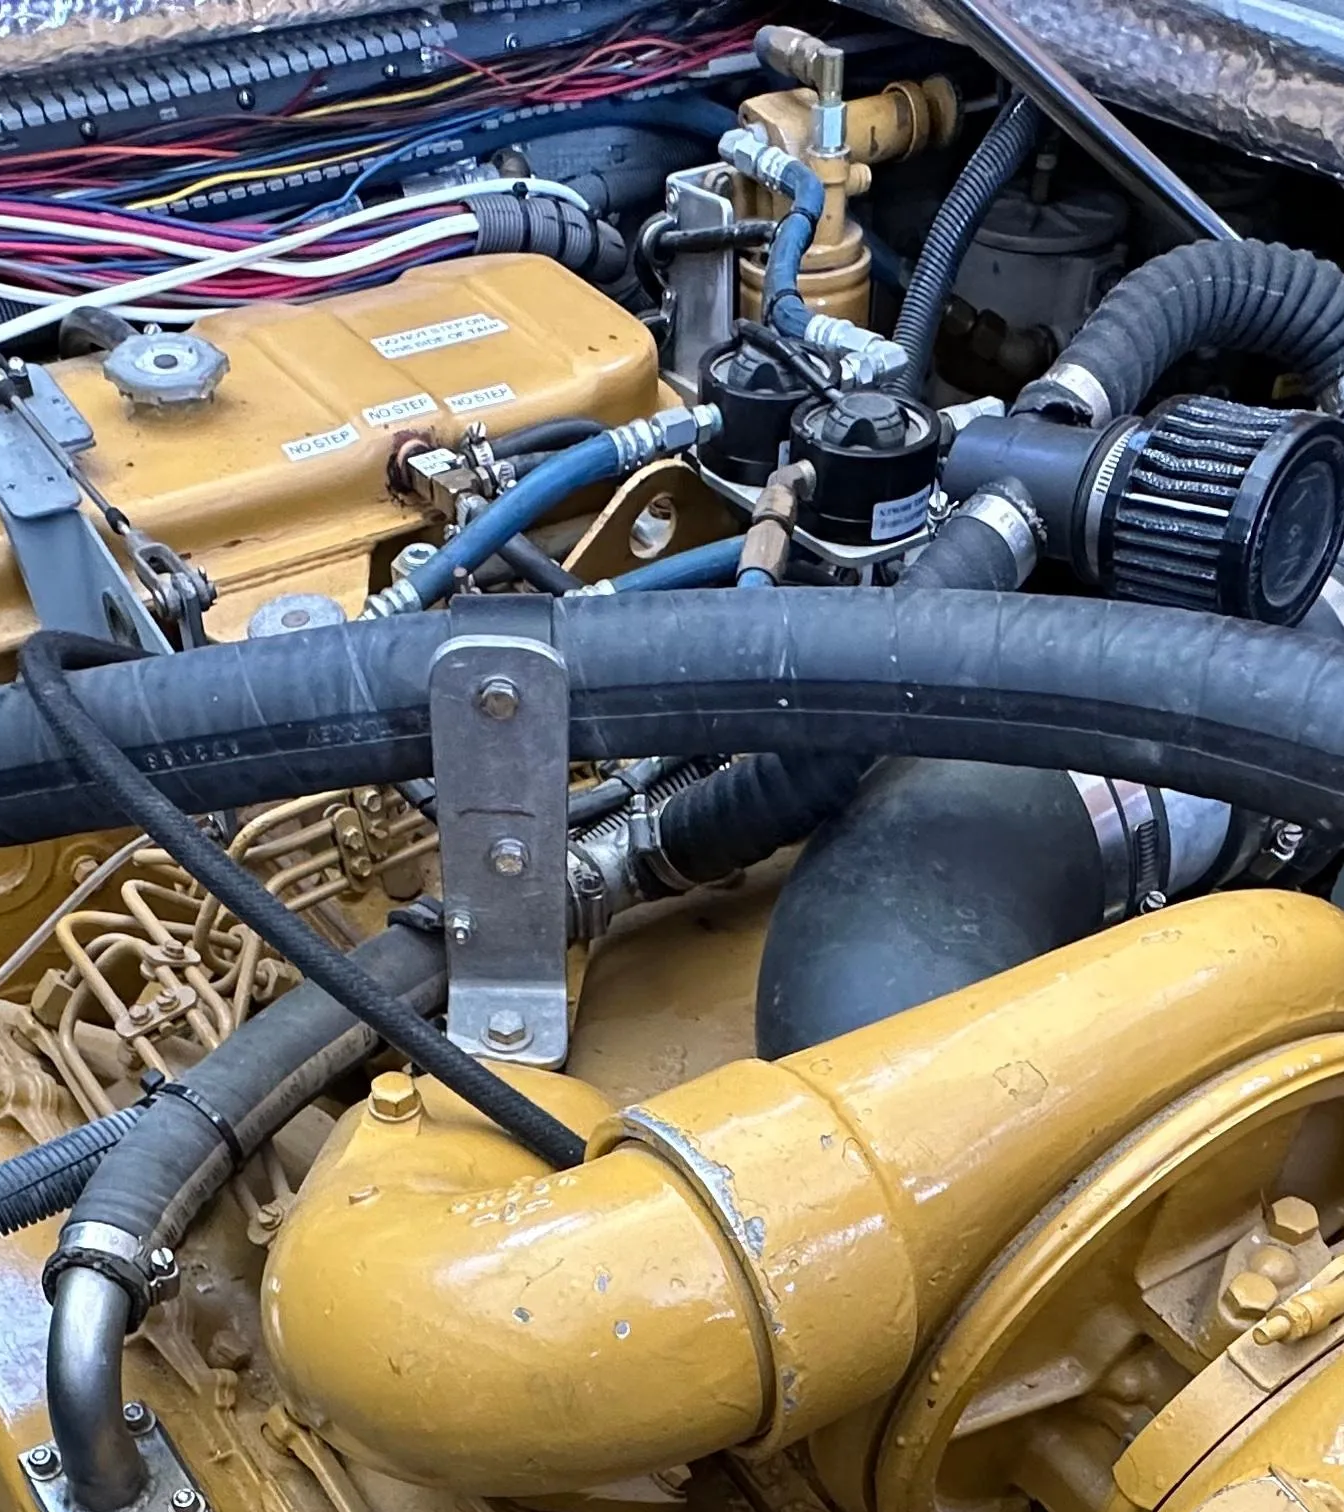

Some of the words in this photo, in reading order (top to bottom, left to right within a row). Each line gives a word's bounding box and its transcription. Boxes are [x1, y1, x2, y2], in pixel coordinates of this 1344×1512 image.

[399, 331, 427, 342] NOT
[430, 322, 463, 334] STEP
[447, 330, 465, 340] OF
[450, 395, 473, 408] NO
[473, 387, 509, 403] STEP
[368, 407, 391, 421] NO
[394, 397, 429, 415] STEP
[288, 441, 312, 455] NO
[315, 430, 351, 448] STEP
